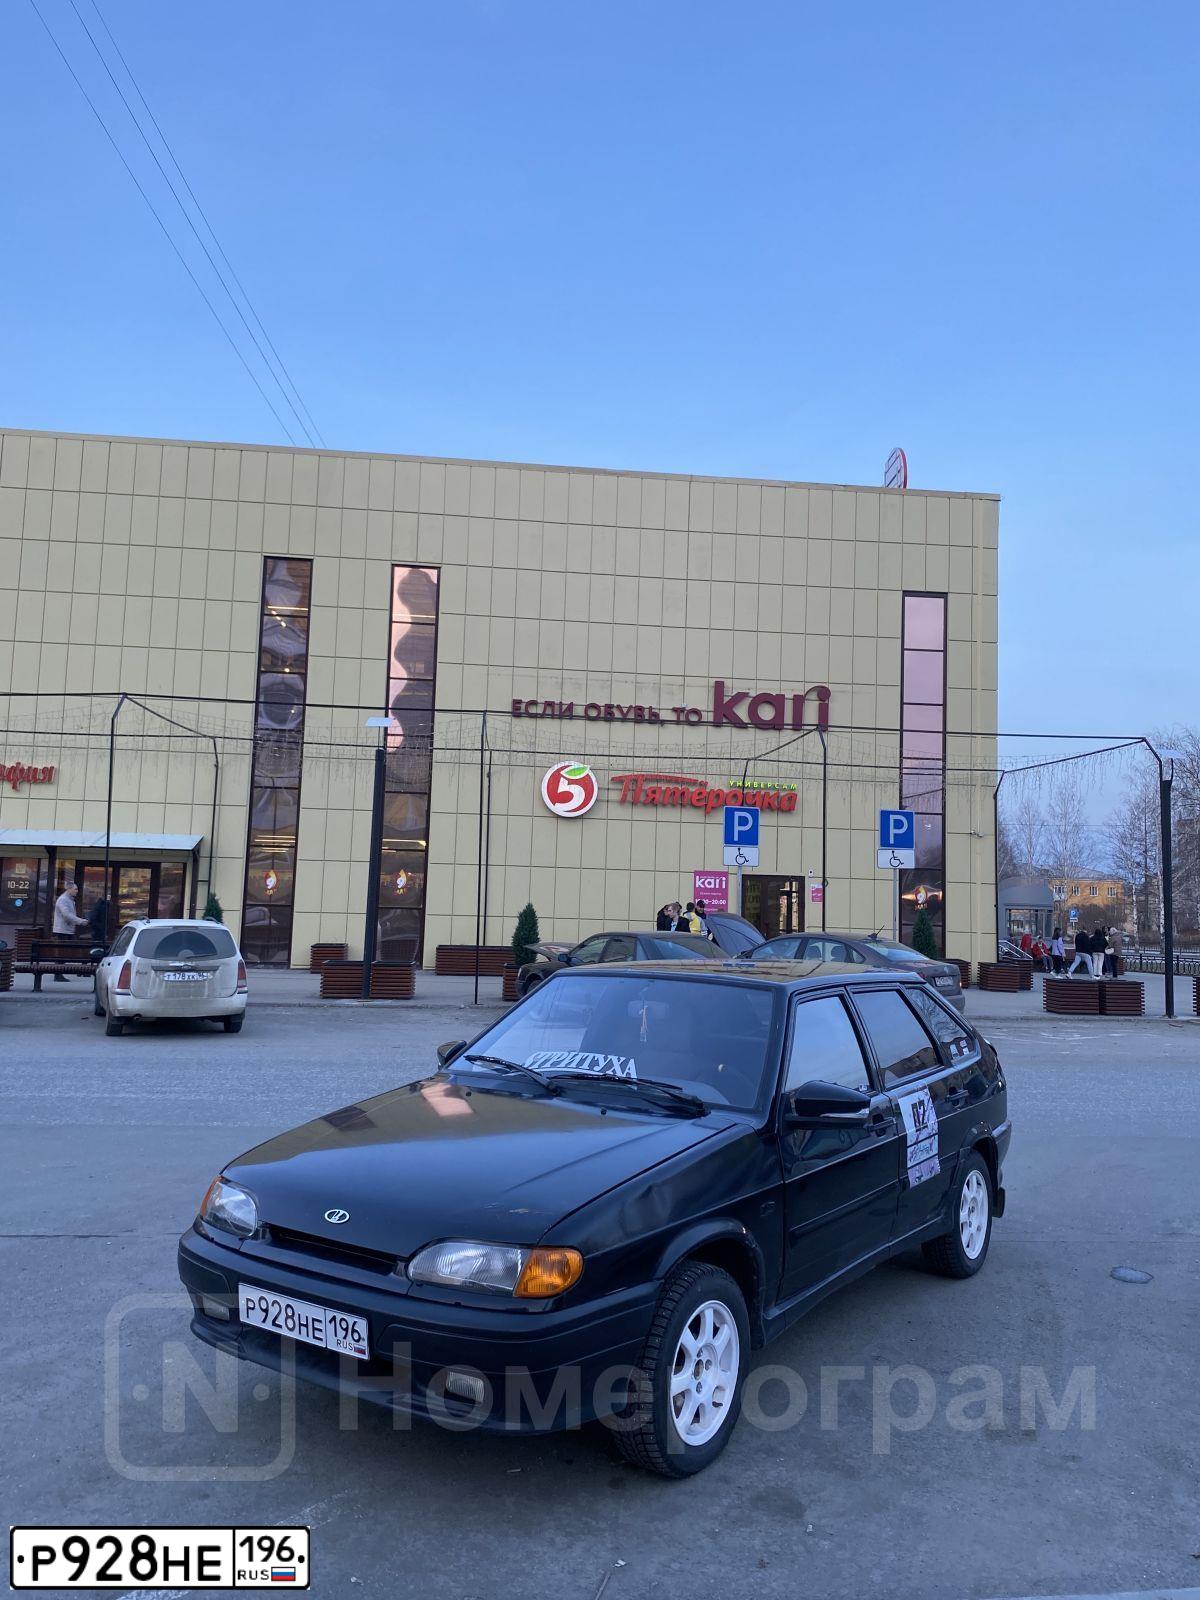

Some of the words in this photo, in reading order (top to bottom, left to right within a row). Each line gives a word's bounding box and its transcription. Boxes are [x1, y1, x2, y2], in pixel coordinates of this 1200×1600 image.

[512, 699, 574, 719] ЕСЛИ
[672, 706, 703, 726] ТО
[713, 680, 832, 732] kari
[611, 774, 799, 814] Пятёрочка
[728, 779, 798, 790] УНИВЕРСАМ
[733, 811, 753, 842] P
[889, 814, 909, 845] P
[695, 875, 727, 889] kari
[245, 1295, 324, 1342] Р928НЕ
[328, 1314, 362, 1343] 196
[336, 1338, 354, 1352] RUS
